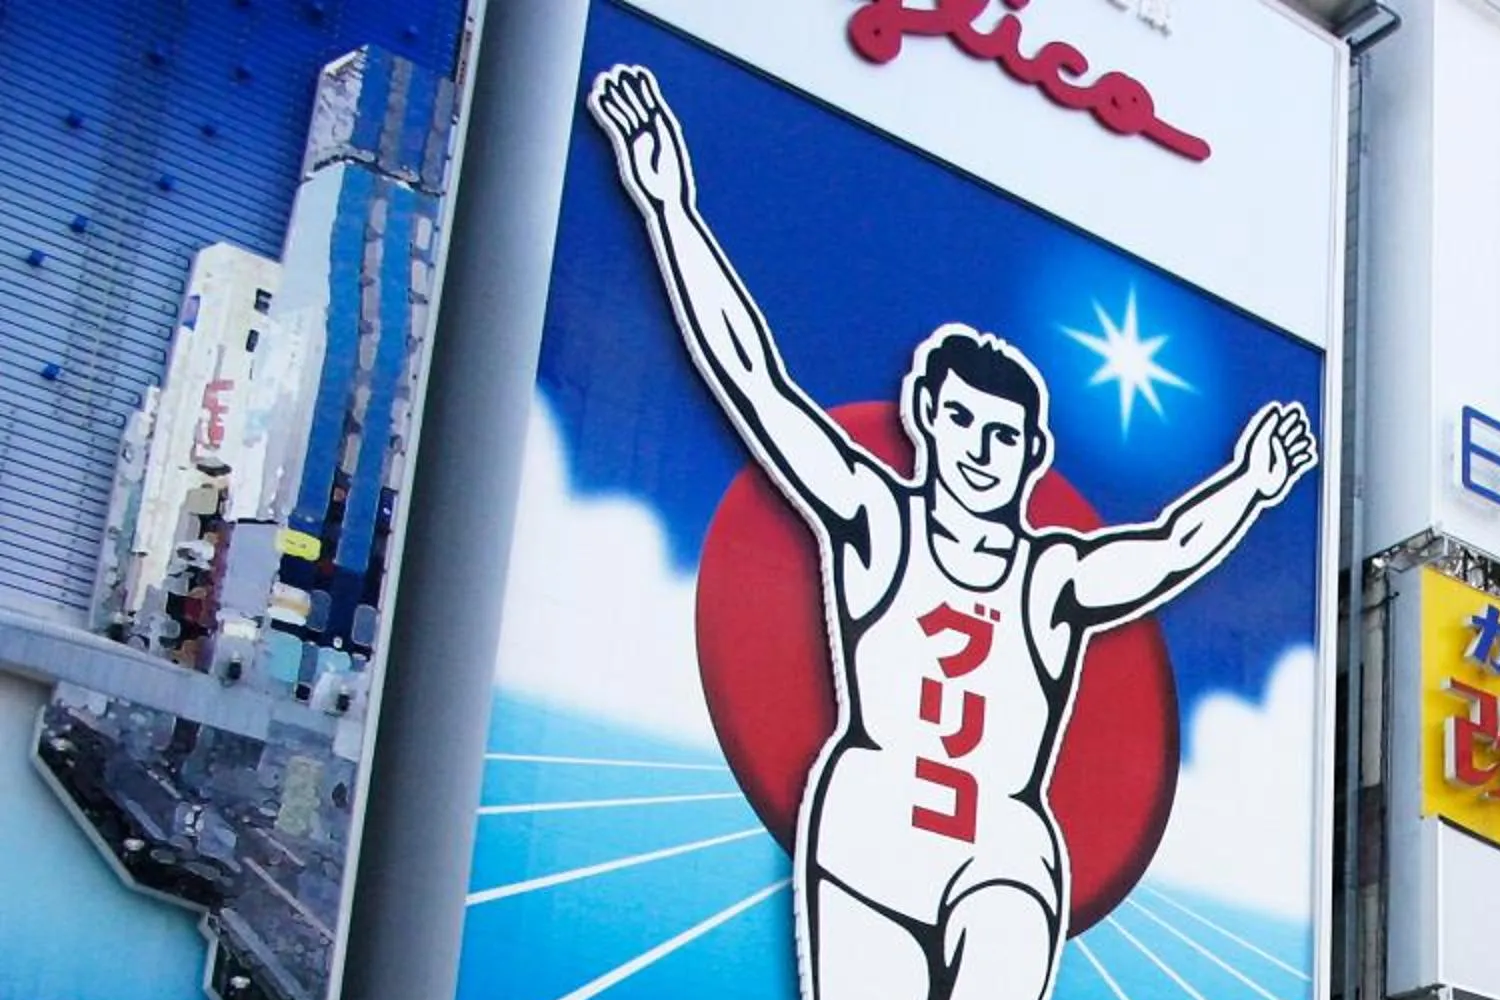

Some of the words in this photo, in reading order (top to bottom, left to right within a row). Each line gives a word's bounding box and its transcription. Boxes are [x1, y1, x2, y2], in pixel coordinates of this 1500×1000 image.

[847, 0, 1211, 163] ico
[911, 601, 1001, 845] グリコ
